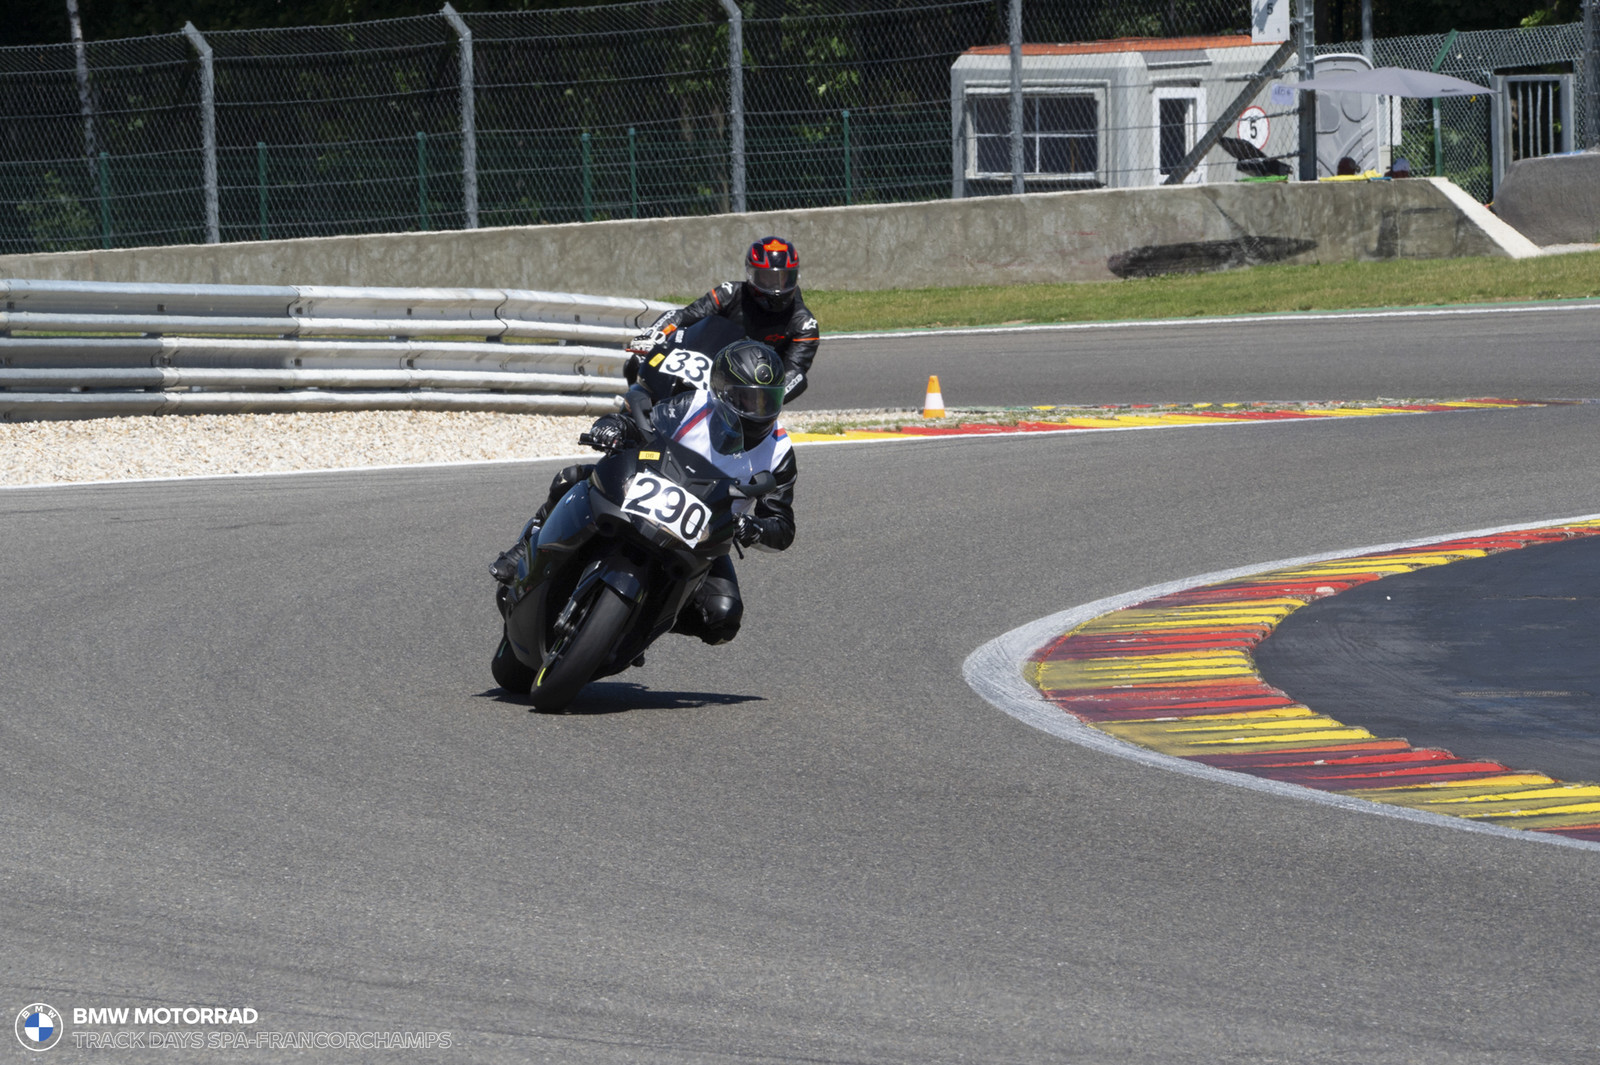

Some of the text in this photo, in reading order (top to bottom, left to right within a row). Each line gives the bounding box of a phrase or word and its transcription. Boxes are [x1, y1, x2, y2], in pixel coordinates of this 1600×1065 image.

[1266, 2, 1274, 16] 5
[1250, 119, 1258, 139] 5
[665, 351, 710, 391] 33
[624, 477, 706, 540] 290
